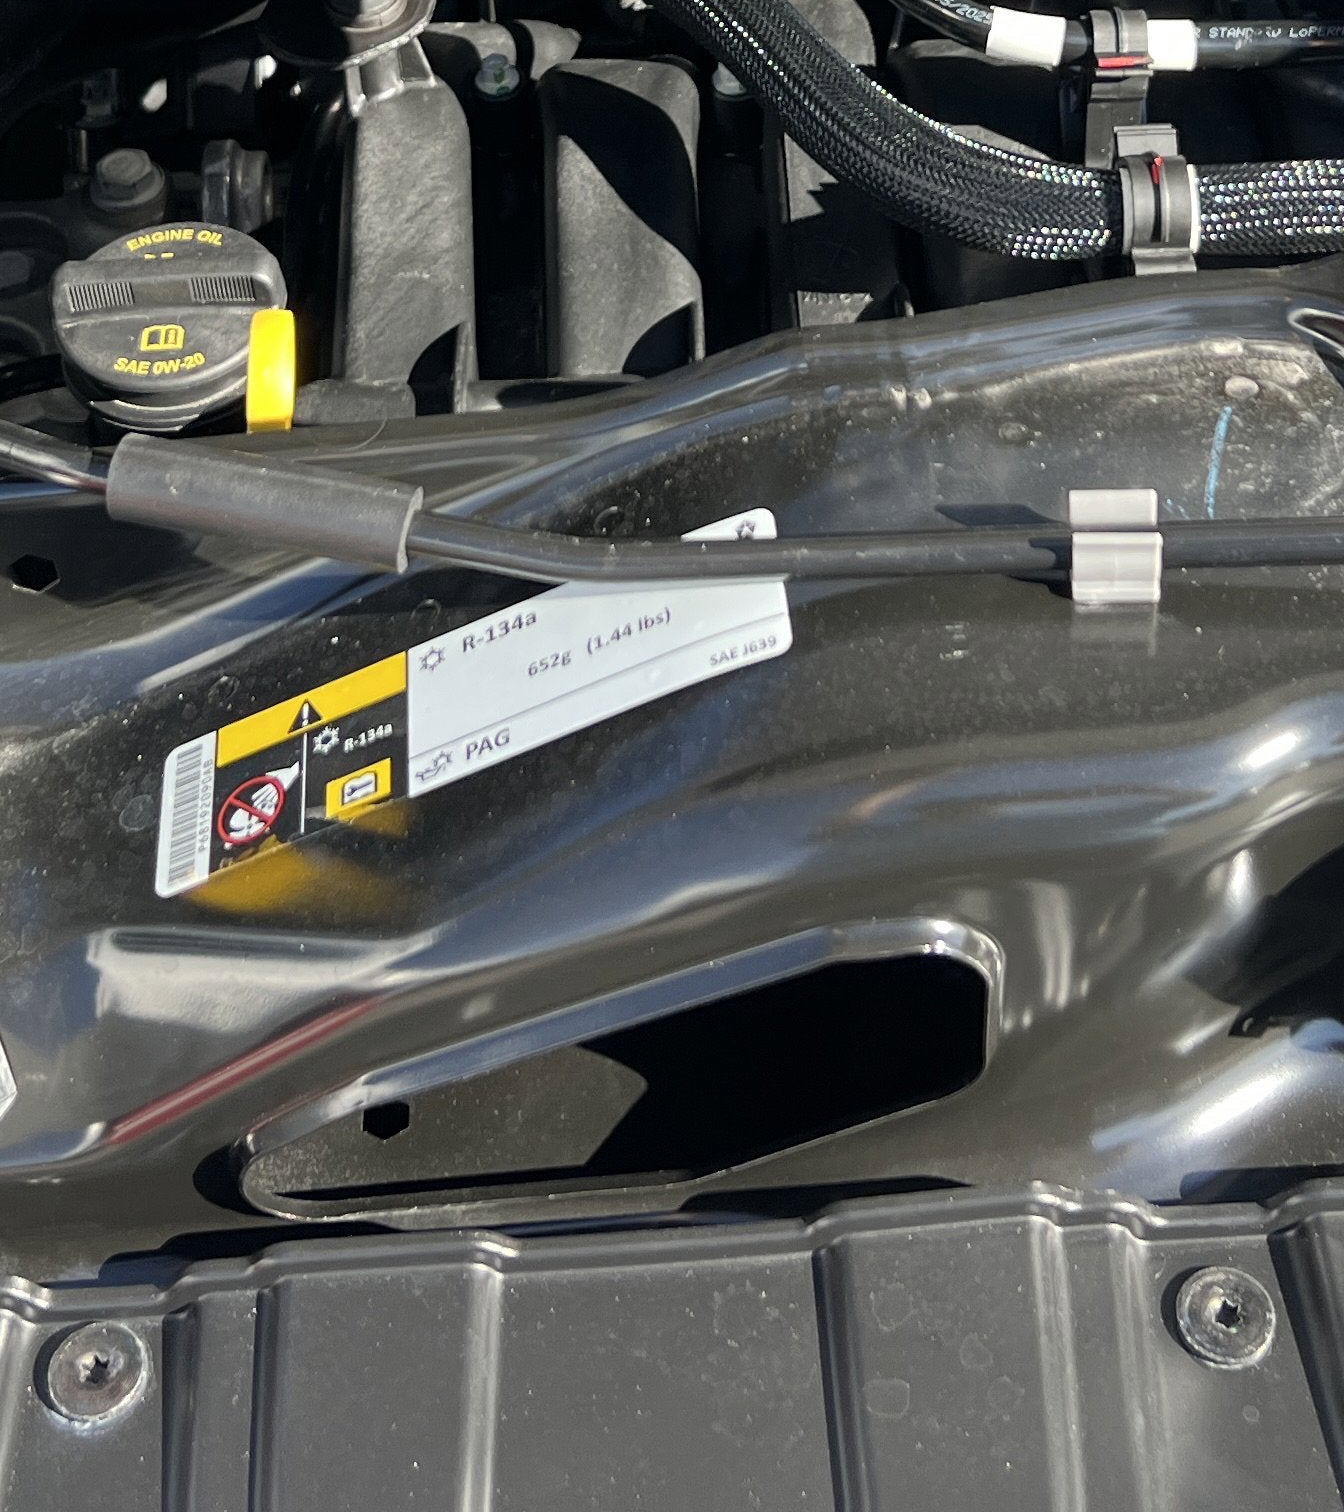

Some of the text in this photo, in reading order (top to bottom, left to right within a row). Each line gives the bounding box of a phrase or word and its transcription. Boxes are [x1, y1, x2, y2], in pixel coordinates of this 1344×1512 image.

[126, 228, 224, 252] ENGINE OIL
[113, 351, 205, 376] SAE 0W-20
[462, 611, 538, 653] R-134a
[527, 606, 672, 678] 652g (1.44 lbs)
[709, 635, 777, 666] SAE J639
[343, 724, 393, 753] R-134a
[465, 727, 511, 760] PAG
